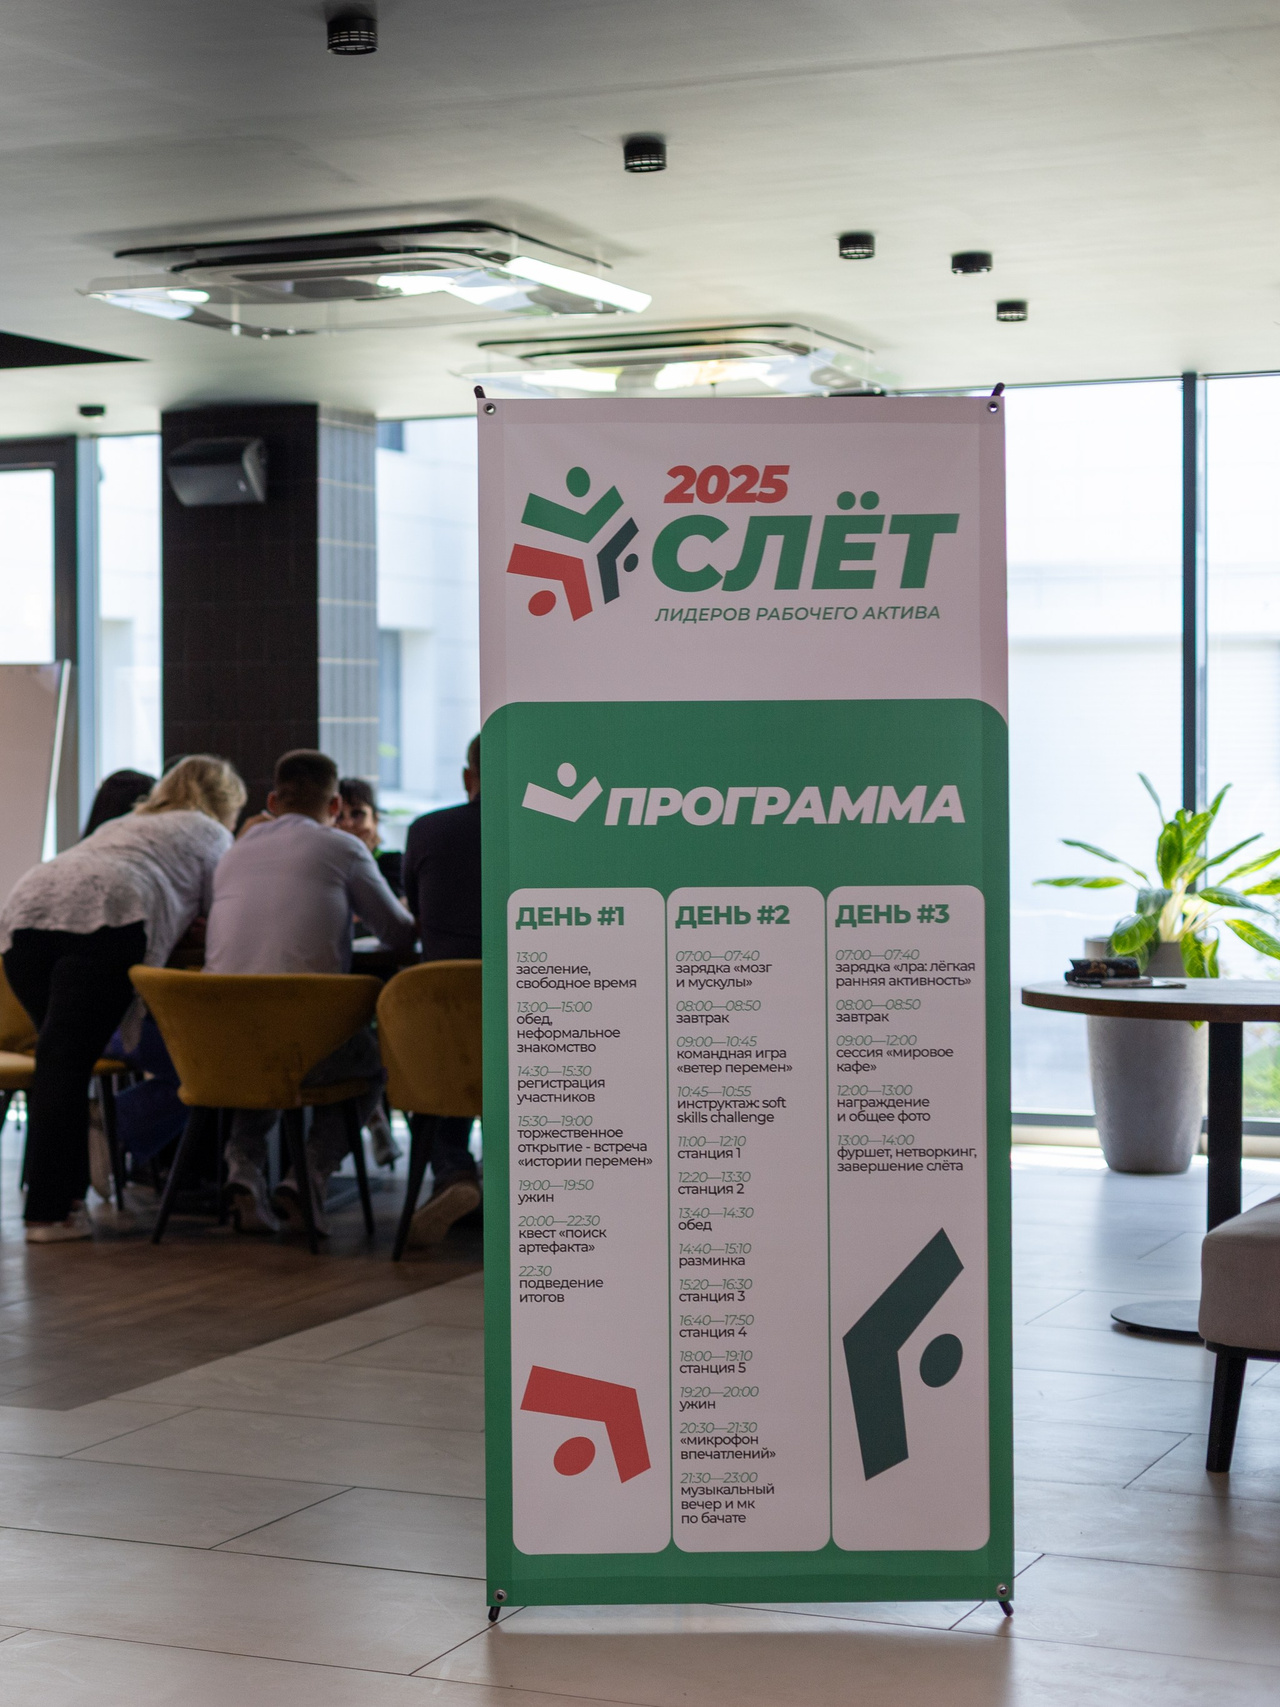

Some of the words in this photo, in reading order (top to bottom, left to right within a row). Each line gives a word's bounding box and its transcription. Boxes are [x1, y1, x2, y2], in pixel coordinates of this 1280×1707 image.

[663, 464, 790, 505] 2025
[651, 489, 960, 594] СЛЁТ
[654, 607, 751, 625] ЛИДЕРОВ
[756, 605, 858, 622] РАБОЧЕГО
[862, 604, 941, 621] АКТИВА
[604, 784, 966, 827] ПРОГРАММА
[515, 906, 593, 931] ДЕНЬ
[597, 906, 625, 927] #1
[675, 905, 751, 929] ДЕНЬ
[756, 905, 790, 925] #2
[835, 904, 912, 928] ДЕНЬ
[916, 903, 950, 924] #3
[516, 951, 548, 963] 13:00
[516, 963, 591, 978] заселение,
[675, 963, 731, 976] зарядка
[733, 963, 773, 974] «мозг
[835, 962, 891, 975] зарядка
[929, 959, 976, 973] лёгкая
[516, 976, 591, 991] свободное
[593, 977, 637, 990] время
[676, 978, 686, 988] и
[688, 977, 753, 990] мускулы»
[835, 976, 886, 989] ранняя
[888, 976, 972, 986] активность»
[516, 1012, 553, 1027] обед,
[676, 1013, 730, 1026] завтрак
[835, 1012, 890, 1024] завтрак
[516, 1026, 621, 1041] неформальное
[516, 1042, 596, 1054] знакомство
[836, 1048, 883, 1058] сессия
[886, 1047, 954, 1060] «мировое
[677, 1049, 752, 1062] командная
[754, 1049, 787, 1061] игра
[677, 1063, 723, 1076] «ветер
[725, 1063, 793, 1075] перемен»
[836, 1060, 877, 1075] кафе»
[517, 1078, 606, 1093] регистрация
[517, 1092, 595, 1106] участников
[762, 1096, 787, 1109] soft
[837, 1098, 930, 1110] награждение
[677, 1112, 708, 1124] skills
[710, 1111, 775, 1126] challenge
[837, 1112, 847, 1122] и
[849, 1111, 895, 1124] общее
[897, 1110, 931, 1125] фото
[517, 1128, 624, 1142] торжественное
[517, 1142, 583, 1156] открытие
[593, 1141, 648, 1155] встреча
[677, 1148, 734, 1161] станция
[736, 1148, 741, 1159] 1
[837, 1147, 893, 1161] фуршет,
[895, 1147, 977, 1160] нетворкинг,
[517, 1156, 582, 1169] «истории
[585, 1156, 653, 1169] перемен»
[837, 1161, 924, 1174] завершение
[926, 1159, 964, 1172] слёта
[677, 1184, 735, 1197] станция
[736, 1184, 745, 1195] 2
[518, 1192, 555, 1206] ужин
[678, 1218, 712, 1232] обед
[518, 1228, 555, 1239] квест
[559, 1227, 607, 1239] «поиск
[518, 1241, 595, 1256] артефакта»
[679, 1256, 746, 1269] разминка
[518, 1265, 552, 1277] 22:30
[519, 1278, 604, 1291] подведение
[519, 1292, 565, 1304] итогов
[678, 1291, 735, 1305] станция
[737, 1291, 746, 1302] 3
[679, 1327, 735, 1341] станция
[737, 1327, 748, 1338] 4
[679, 1363, 735, 1376] станция
[737, 1362, 747, 1374] 5
[679, 1399, 716, 1412] ужин
[680, 1433, 759, 1448] «микрофон
[681, 1447, 776, 1460] впечатлений»
[681, 1483, 775, 1498] музыкальный
[681, 1499, 722, 1512] вечер
[725, 1499, 734, 1509] и
[736, 1499, 755, 1510] мк
[681, 1514, 699, 1524] по
[701, 1511, 747, 1524] бачате
